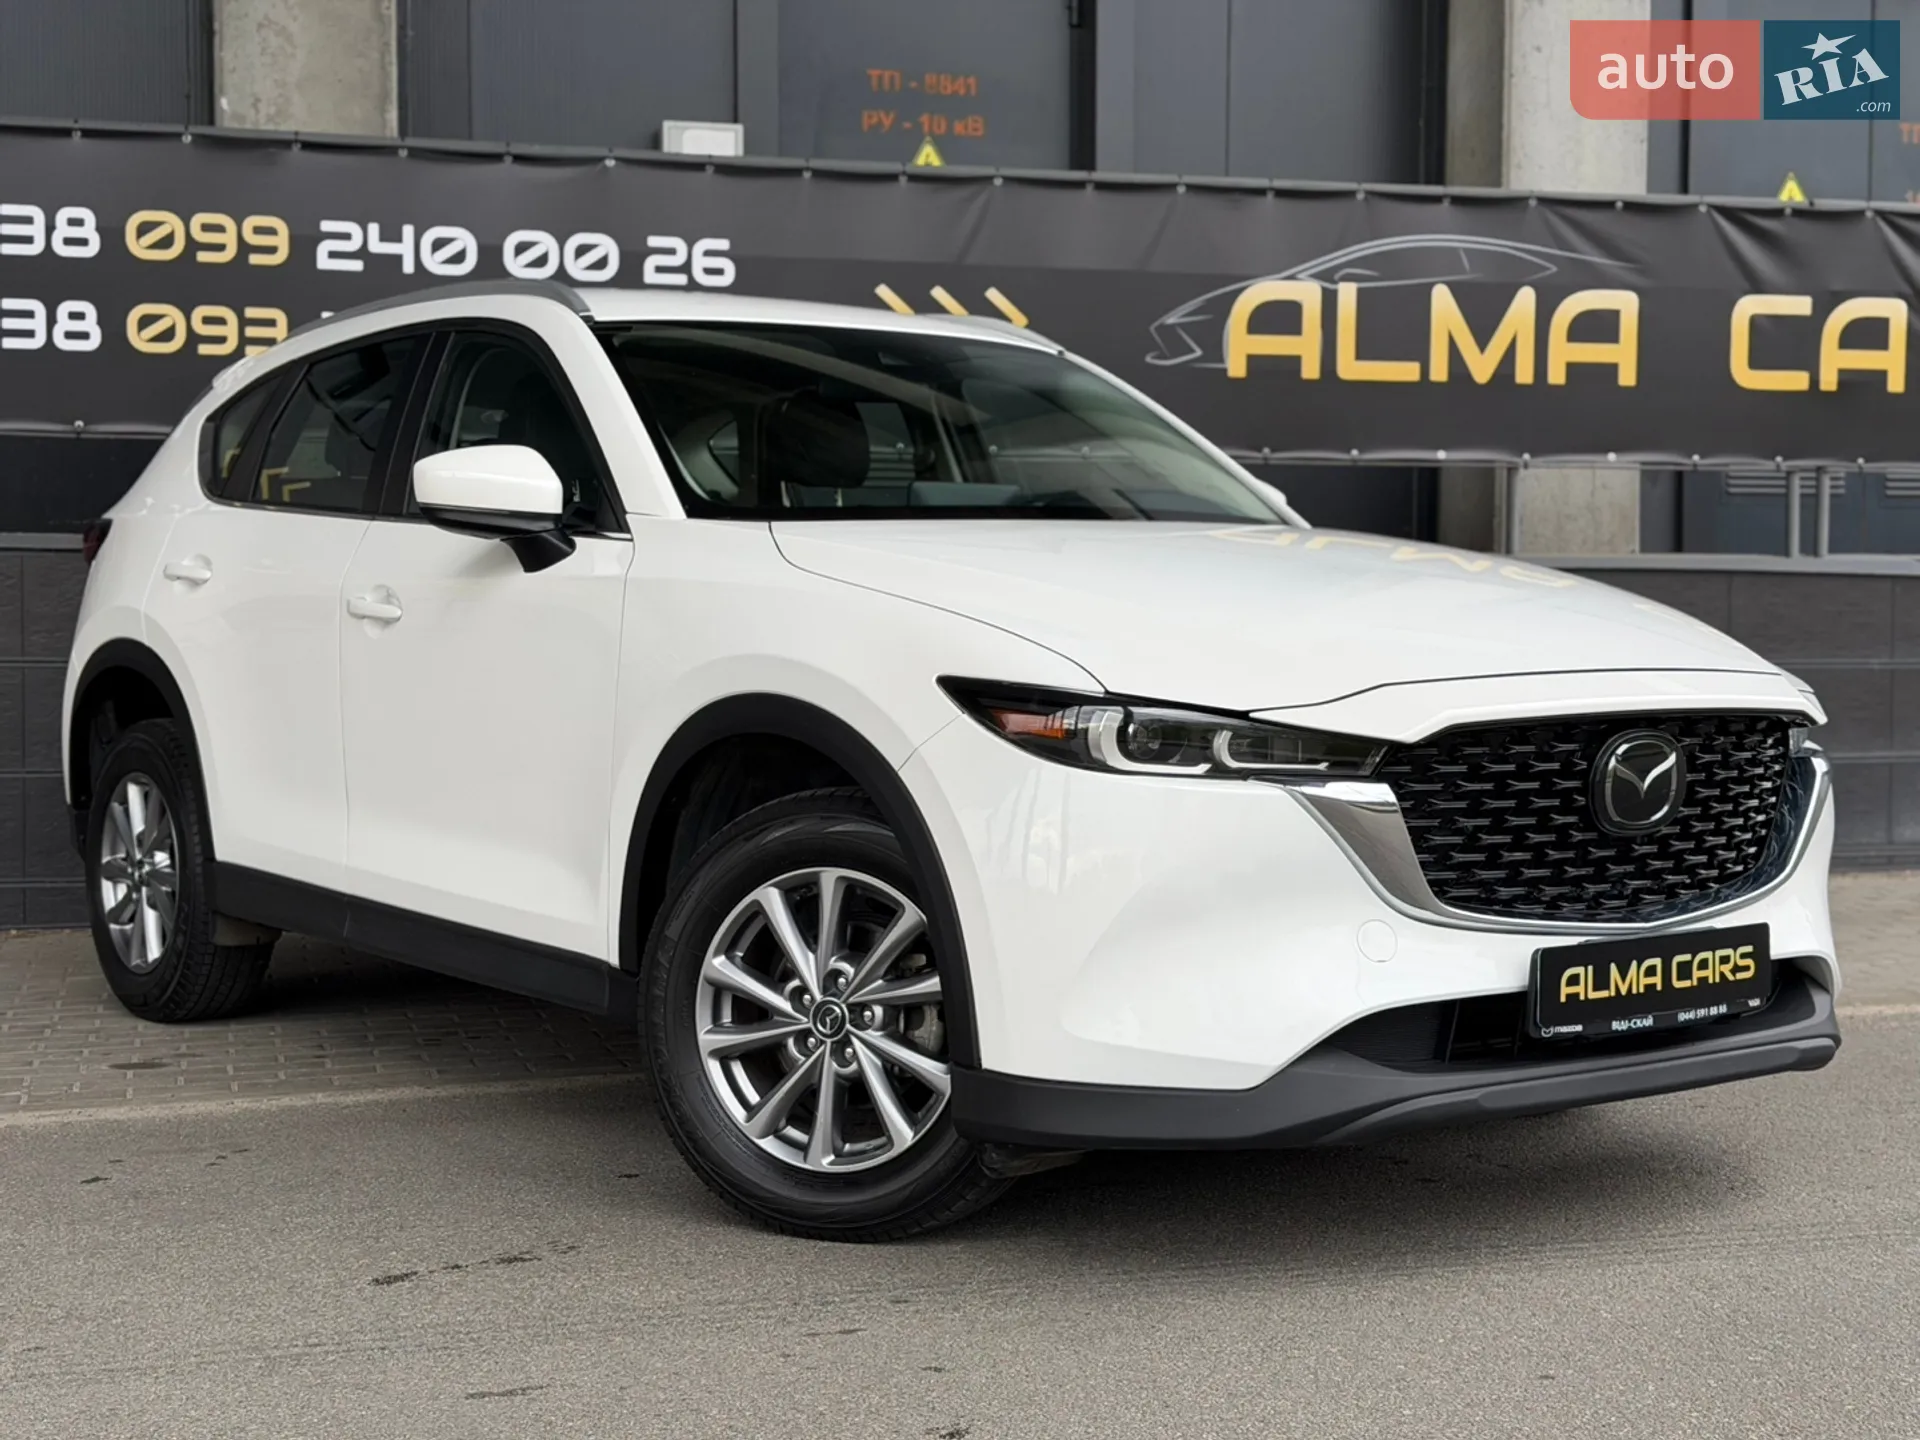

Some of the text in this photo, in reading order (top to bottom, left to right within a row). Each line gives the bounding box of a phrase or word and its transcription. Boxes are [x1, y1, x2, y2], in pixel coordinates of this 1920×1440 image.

[125, 210, 290, 266] 099
[316, 219, 478, 276] 240
[503, 229, 620, 281] 00
[643, 235, 736, 287] 26
[126, 303, 288, 356] 093
[1227, 280, 1909, 393] ALMA CA
[1560, 945, 1756, 1003] ALMA CARS
